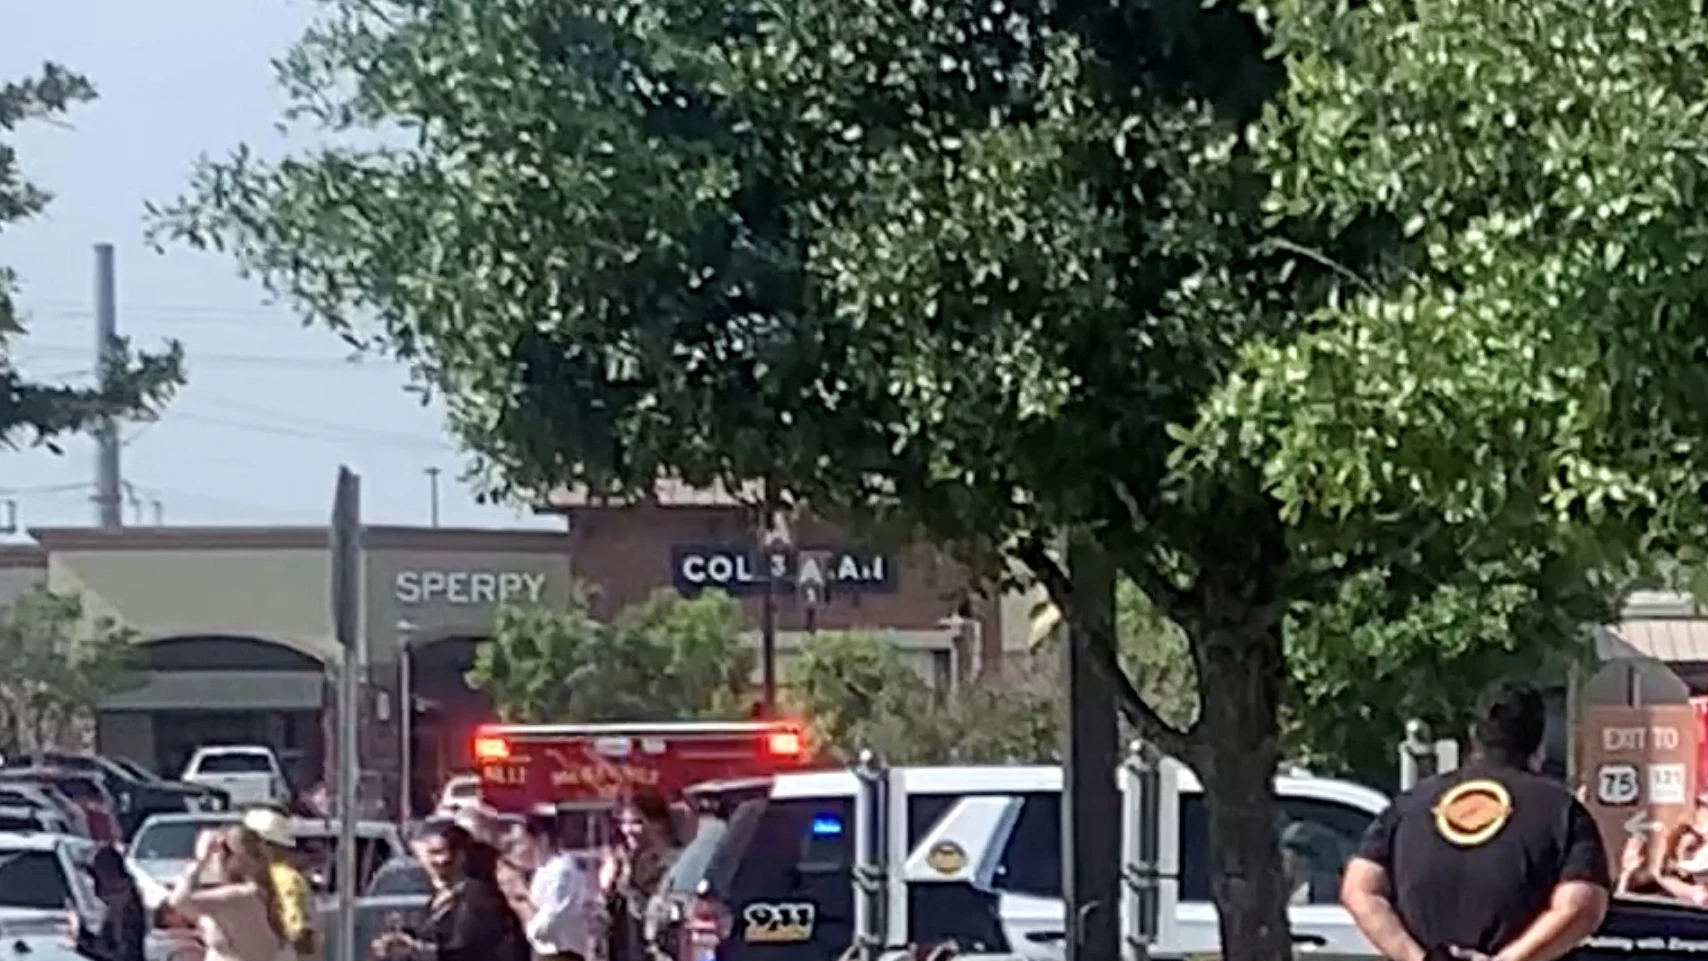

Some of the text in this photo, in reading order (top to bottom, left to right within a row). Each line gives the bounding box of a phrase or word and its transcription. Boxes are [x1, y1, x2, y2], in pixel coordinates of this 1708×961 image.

[1602, 726, 1679, 750] EXIT TO
[1603, 773, 1633, 796] 75
